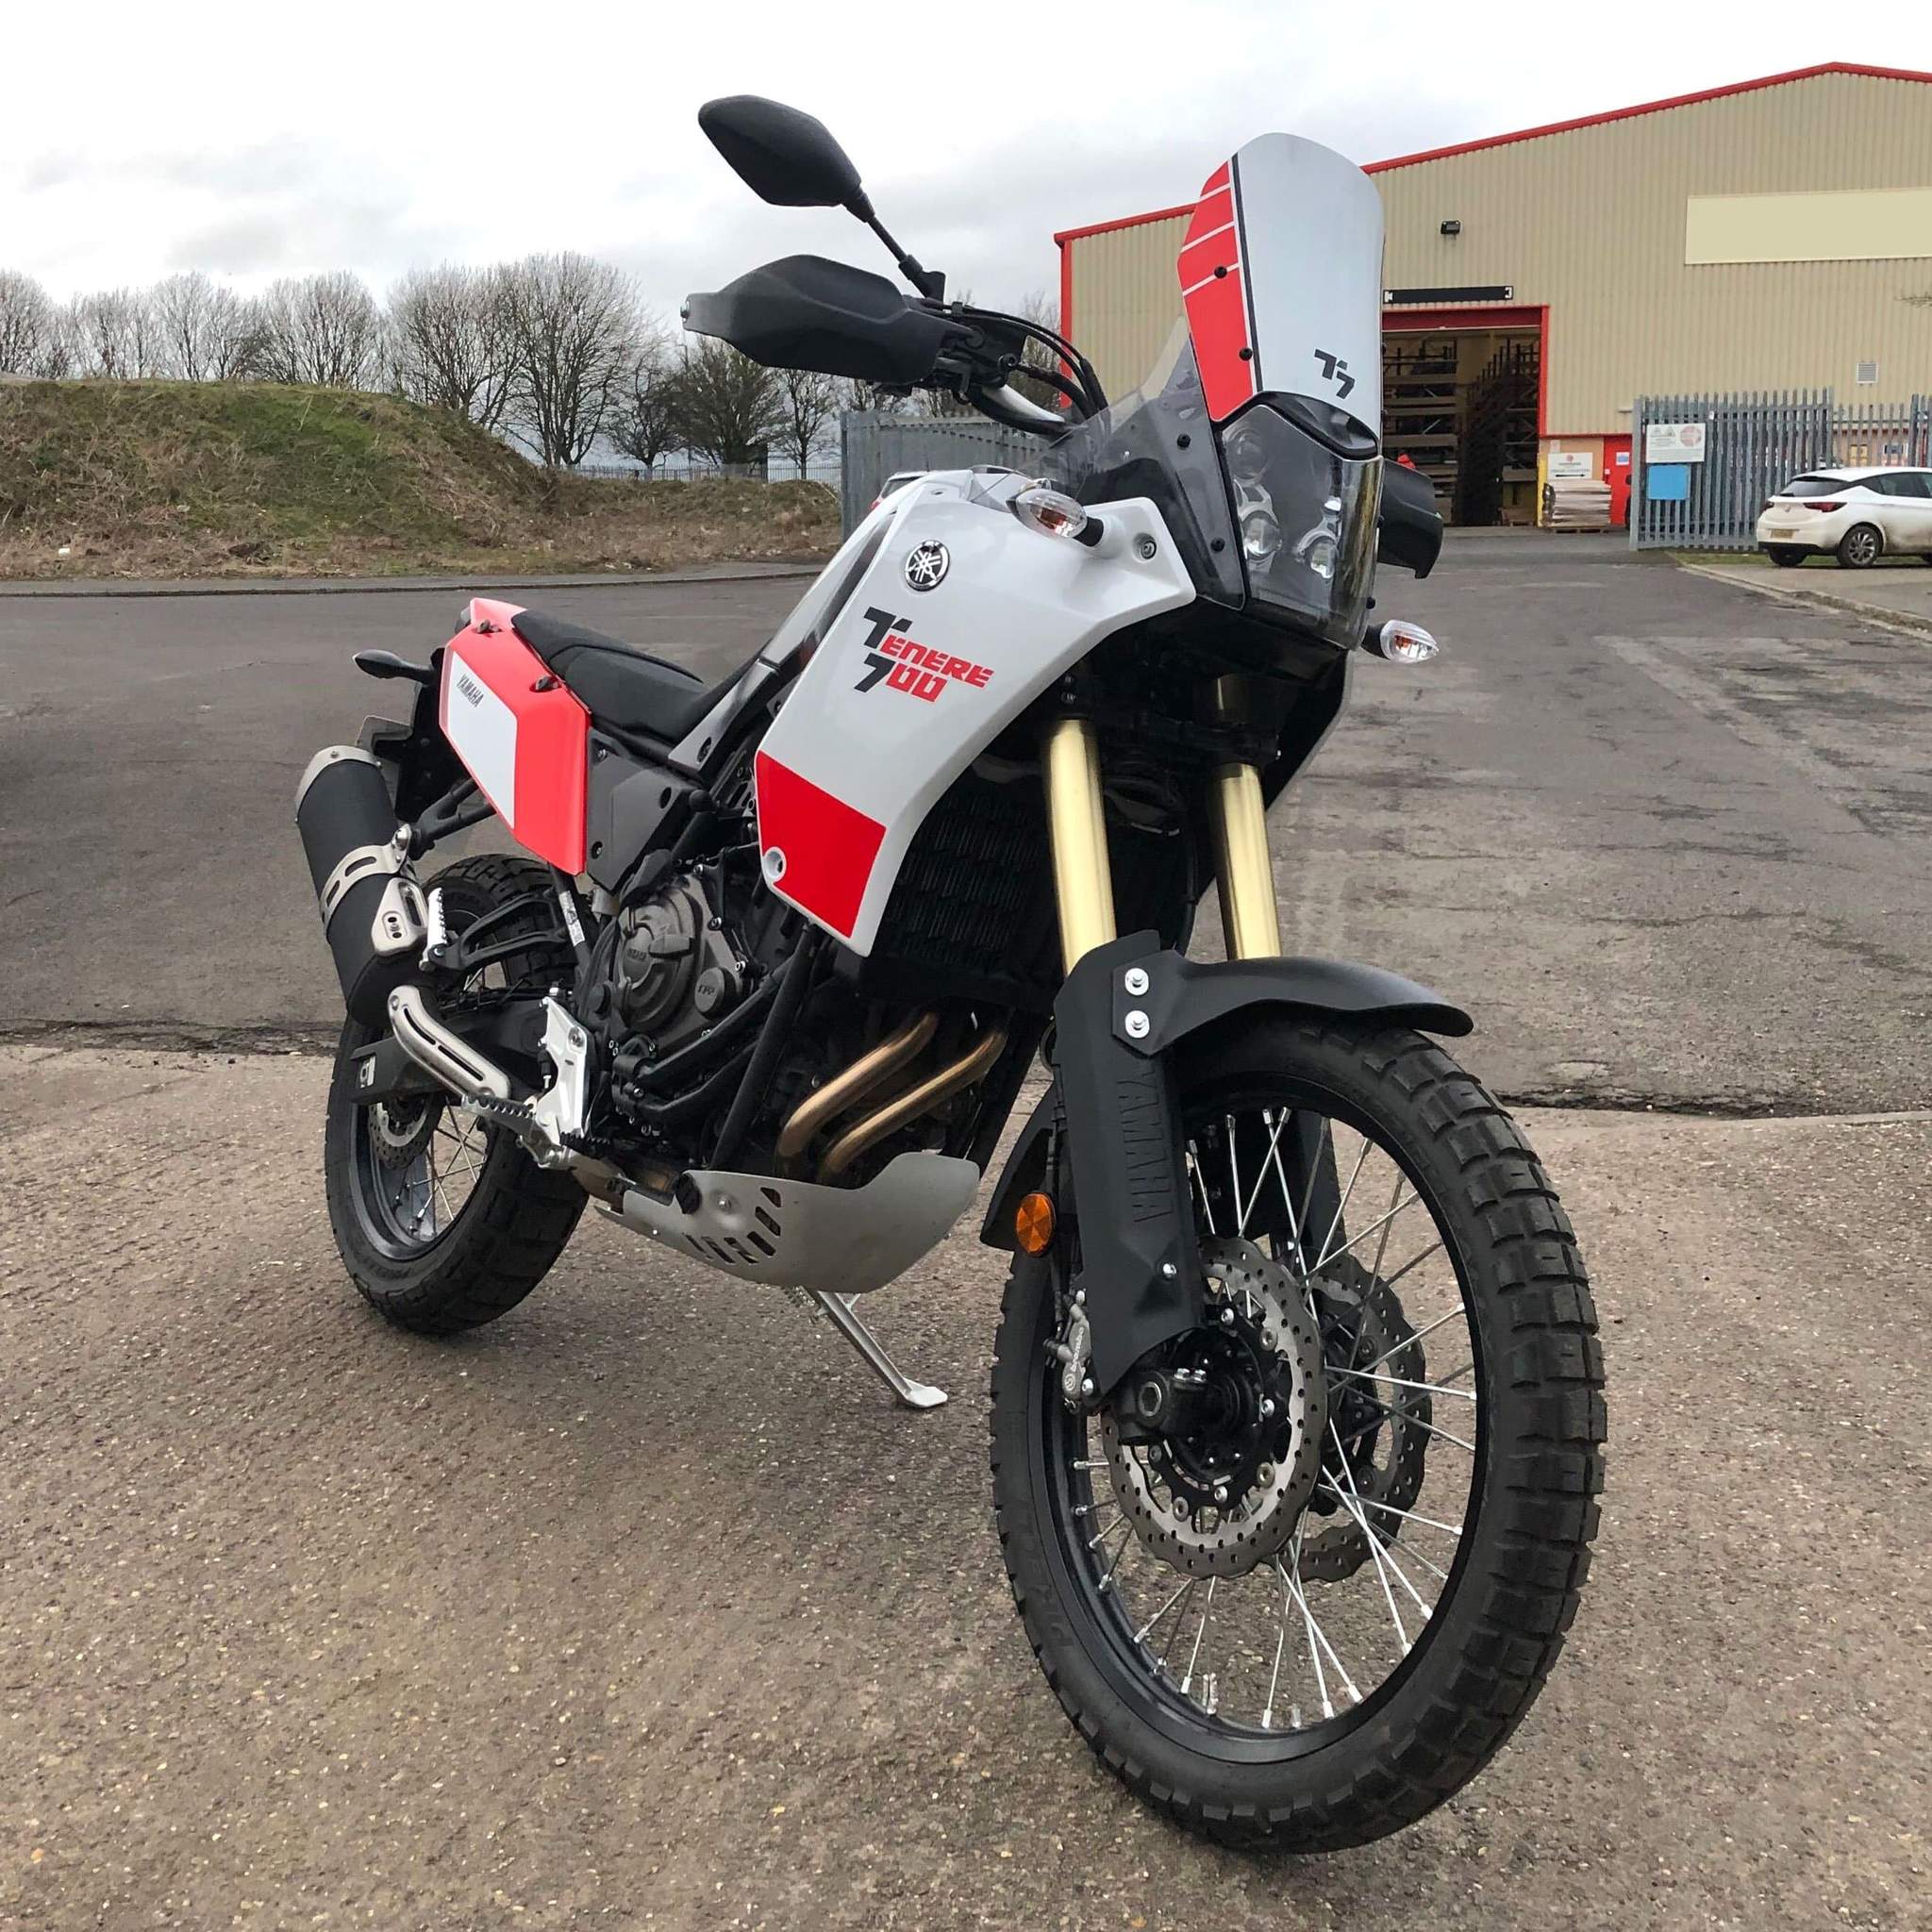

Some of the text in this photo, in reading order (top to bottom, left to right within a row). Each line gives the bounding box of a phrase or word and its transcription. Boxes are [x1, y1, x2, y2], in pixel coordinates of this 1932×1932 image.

[456, 674, 484, 708] YAMAHA
[854, 652, 948, 703] 700
[1117, 1066, 1174, 1223] YAMAHA
